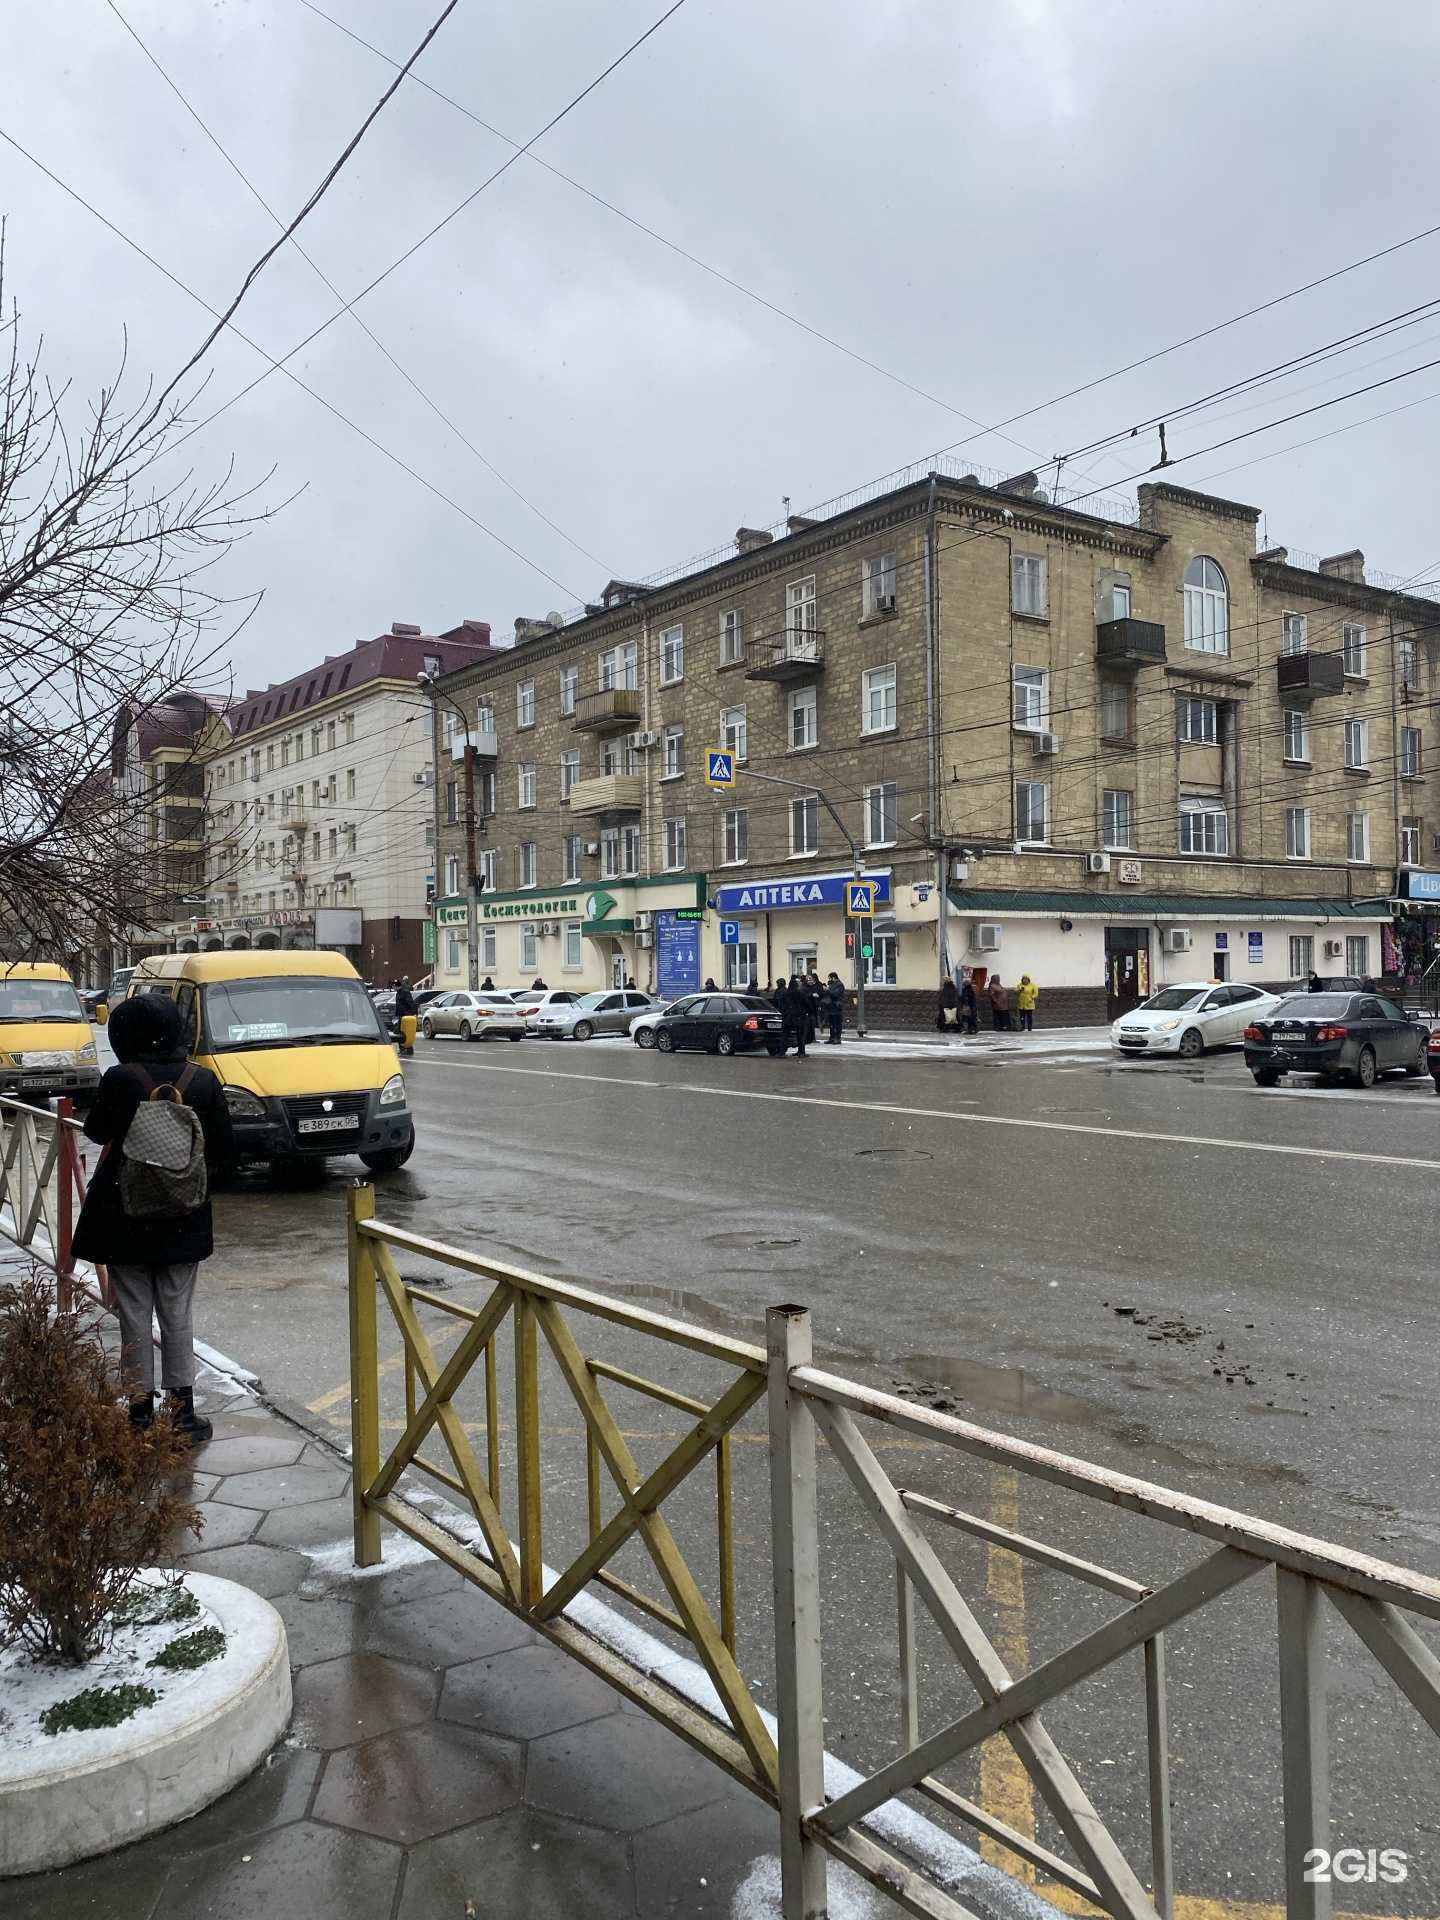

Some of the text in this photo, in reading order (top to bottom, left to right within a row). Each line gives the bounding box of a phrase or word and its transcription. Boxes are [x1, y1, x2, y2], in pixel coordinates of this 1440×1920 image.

[739, 884, 824, 906] АПТЕКА
[440, 900, 577, 923] Цент Косметологии
[231, 1028, 247, 1040] 7
